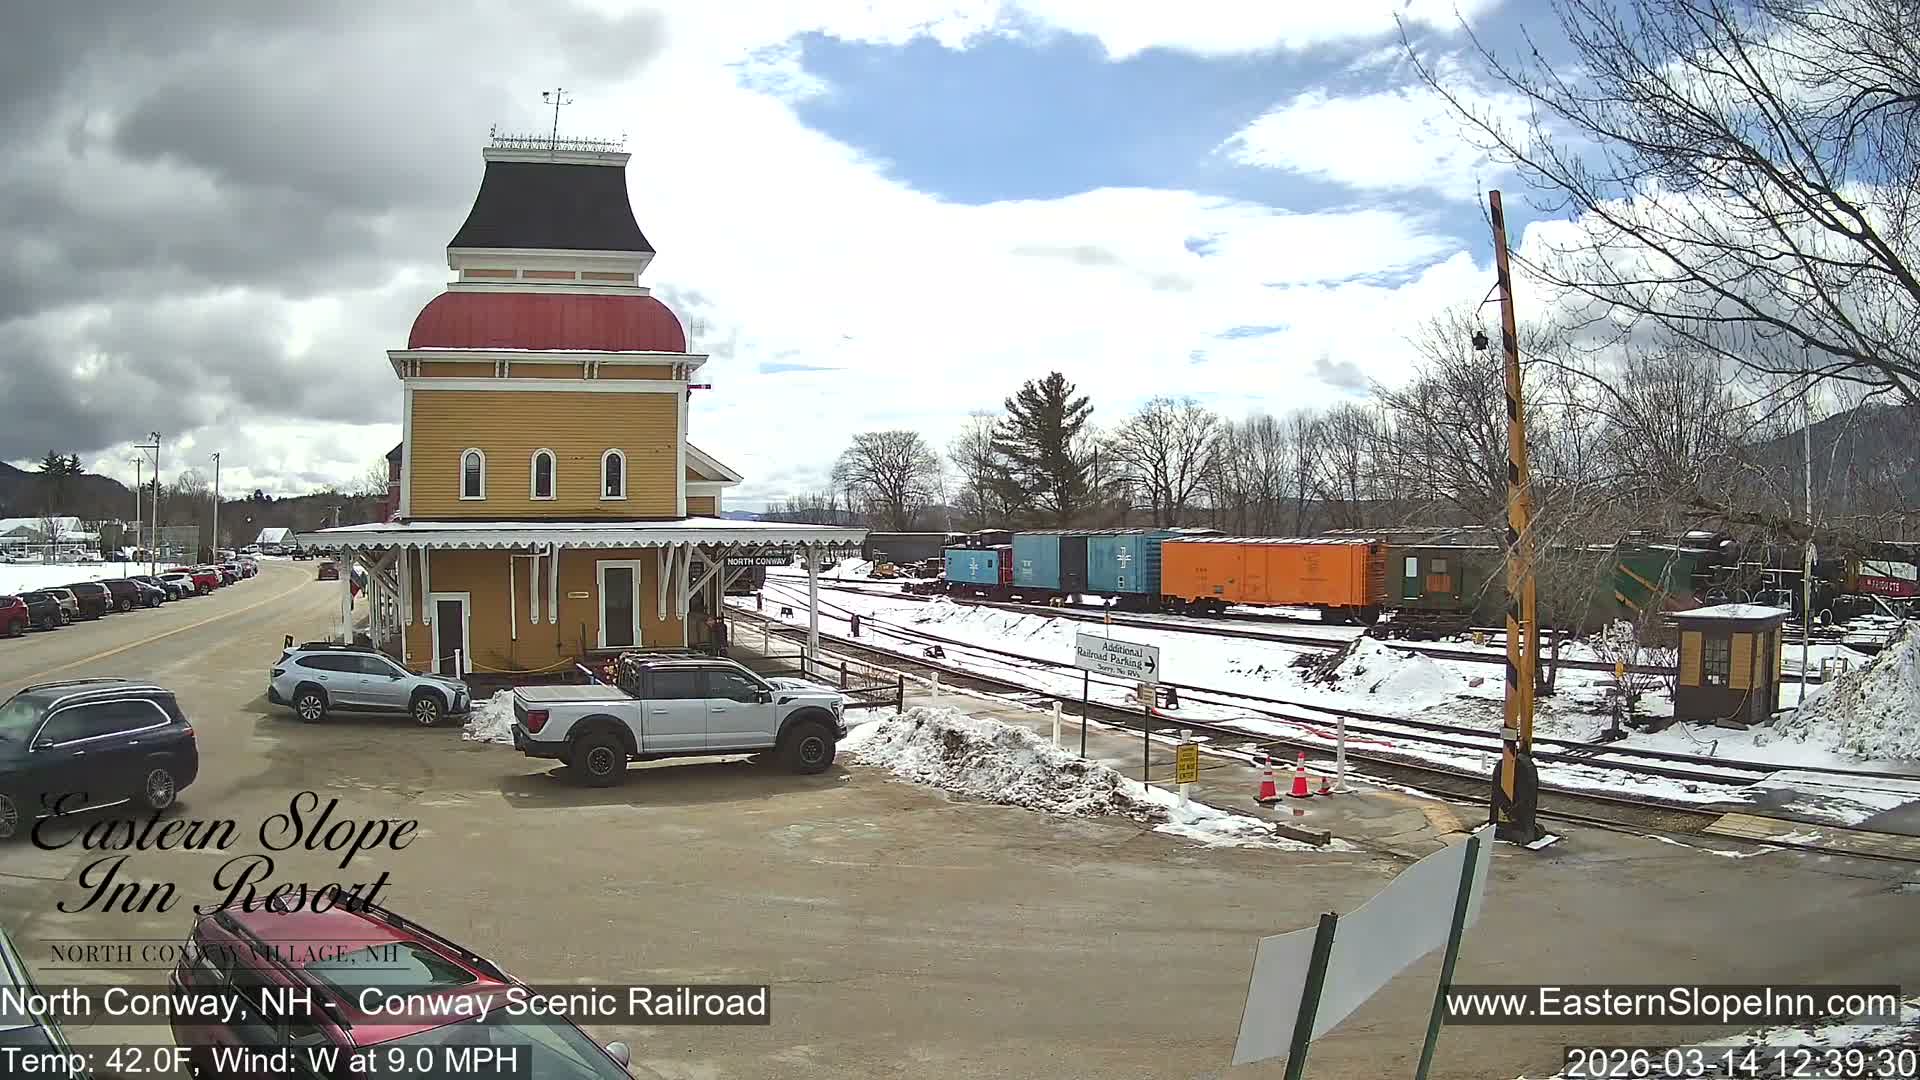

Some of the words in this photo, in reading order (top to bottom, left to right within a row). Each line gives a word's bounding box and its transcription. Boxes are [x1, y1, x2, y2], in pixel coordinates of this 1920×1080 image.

[727, 557, 754, 566] NORTH
[755, 557, 787, 566] CONWAY
[1077, 646, 1108, 661] Railroad
[1110, 653, 1143, 670] Parking
[1103, 641, 1143, 658] Additional
